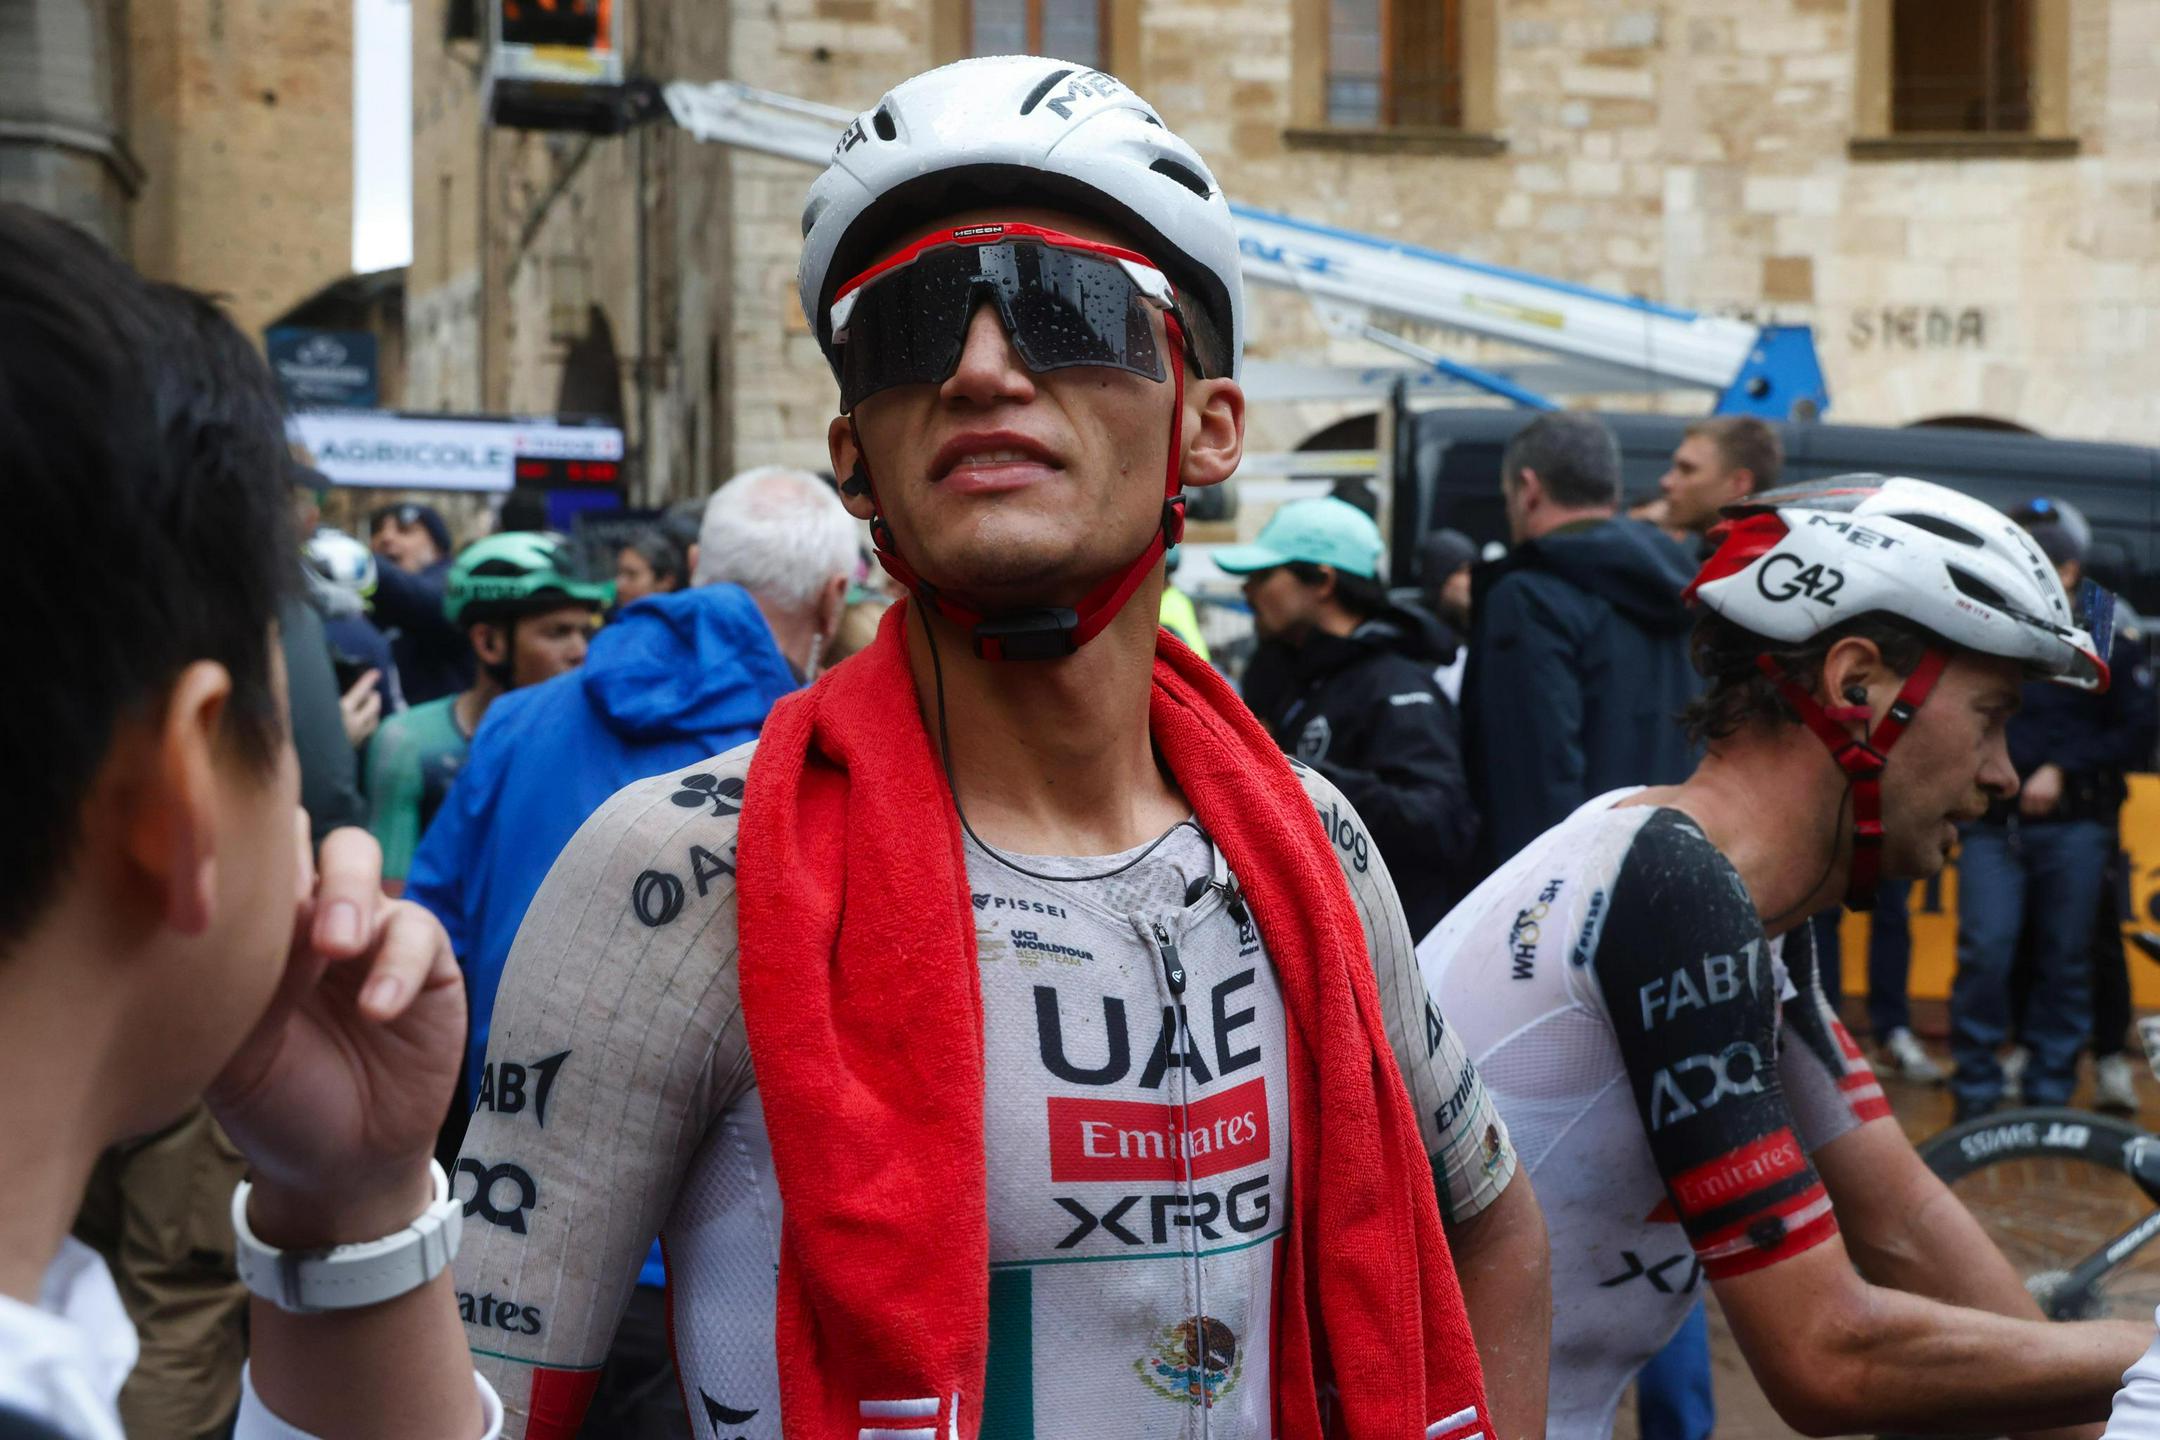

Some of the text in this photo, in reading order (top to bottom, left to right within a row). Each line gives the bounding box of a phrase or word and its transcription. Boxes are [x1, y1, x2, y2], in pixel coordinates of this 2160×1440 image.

[1808, 514, 1905, 550] MET
[1757, 553, 1845, 606] G42
[994, 897, 1067, 919] PISSEI
[1011, 929, 1039, 941] UCI
[1012, 940, 1095, 961] WORLDTOUR
[1034, 968, 1261, 1089] UAE
[1080, 1111, 1257, 1160] Emirates
[1680, 1139, 1797, 1205] Emirates
[1053, 1174, 1271, 1250] XRG
[455, 1292, 542, 1335] ates
